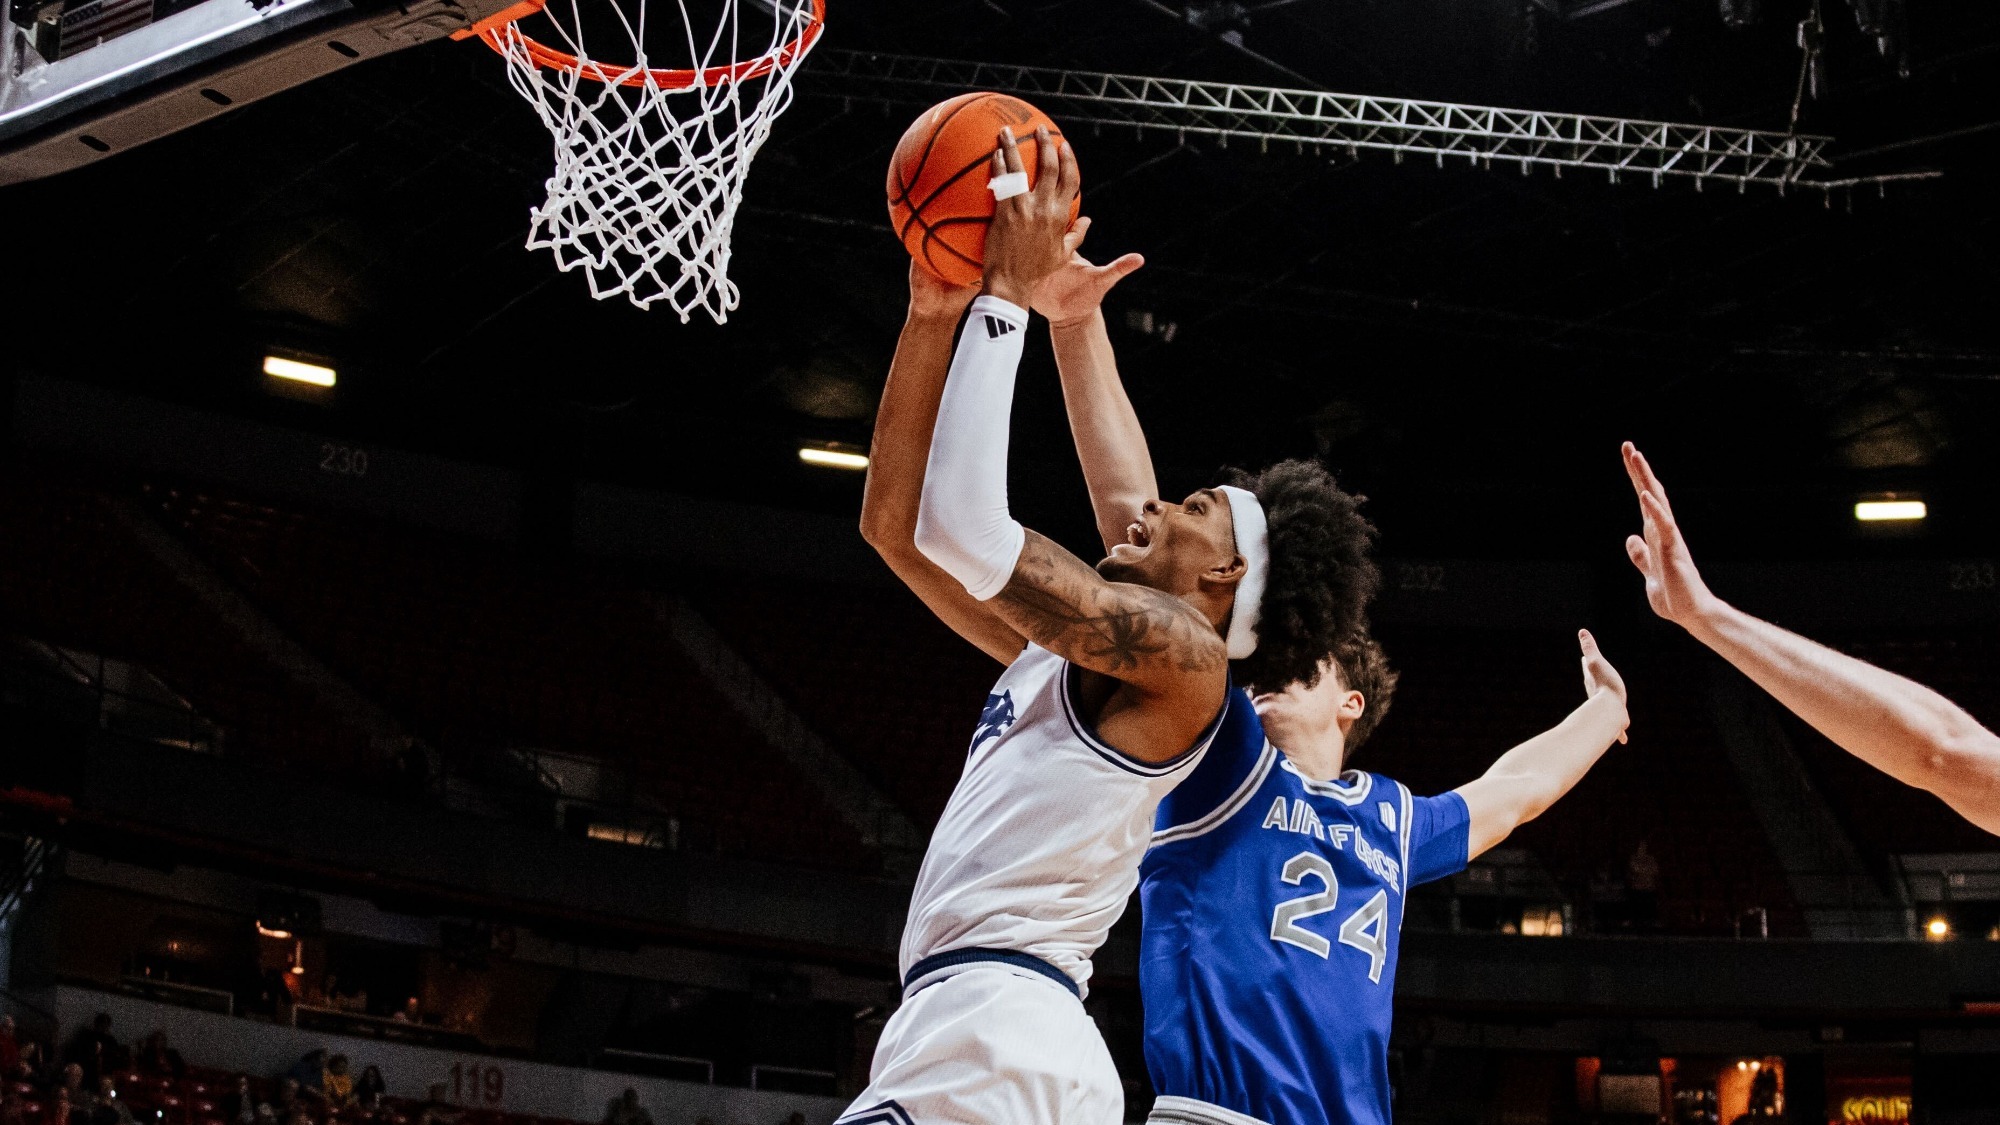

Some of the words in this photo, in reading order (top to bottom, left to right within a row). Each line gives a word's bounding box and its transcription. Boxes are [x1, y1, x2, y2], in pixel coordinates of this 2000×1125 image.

[319, 442, 369, 476] 230
[1262, 796, 1325, 841] AIR
[1328, 824, 1400, 896] FORCE
[1270, 851, 1388, 985] 24
[449, 1062, 504, 1103] 119
